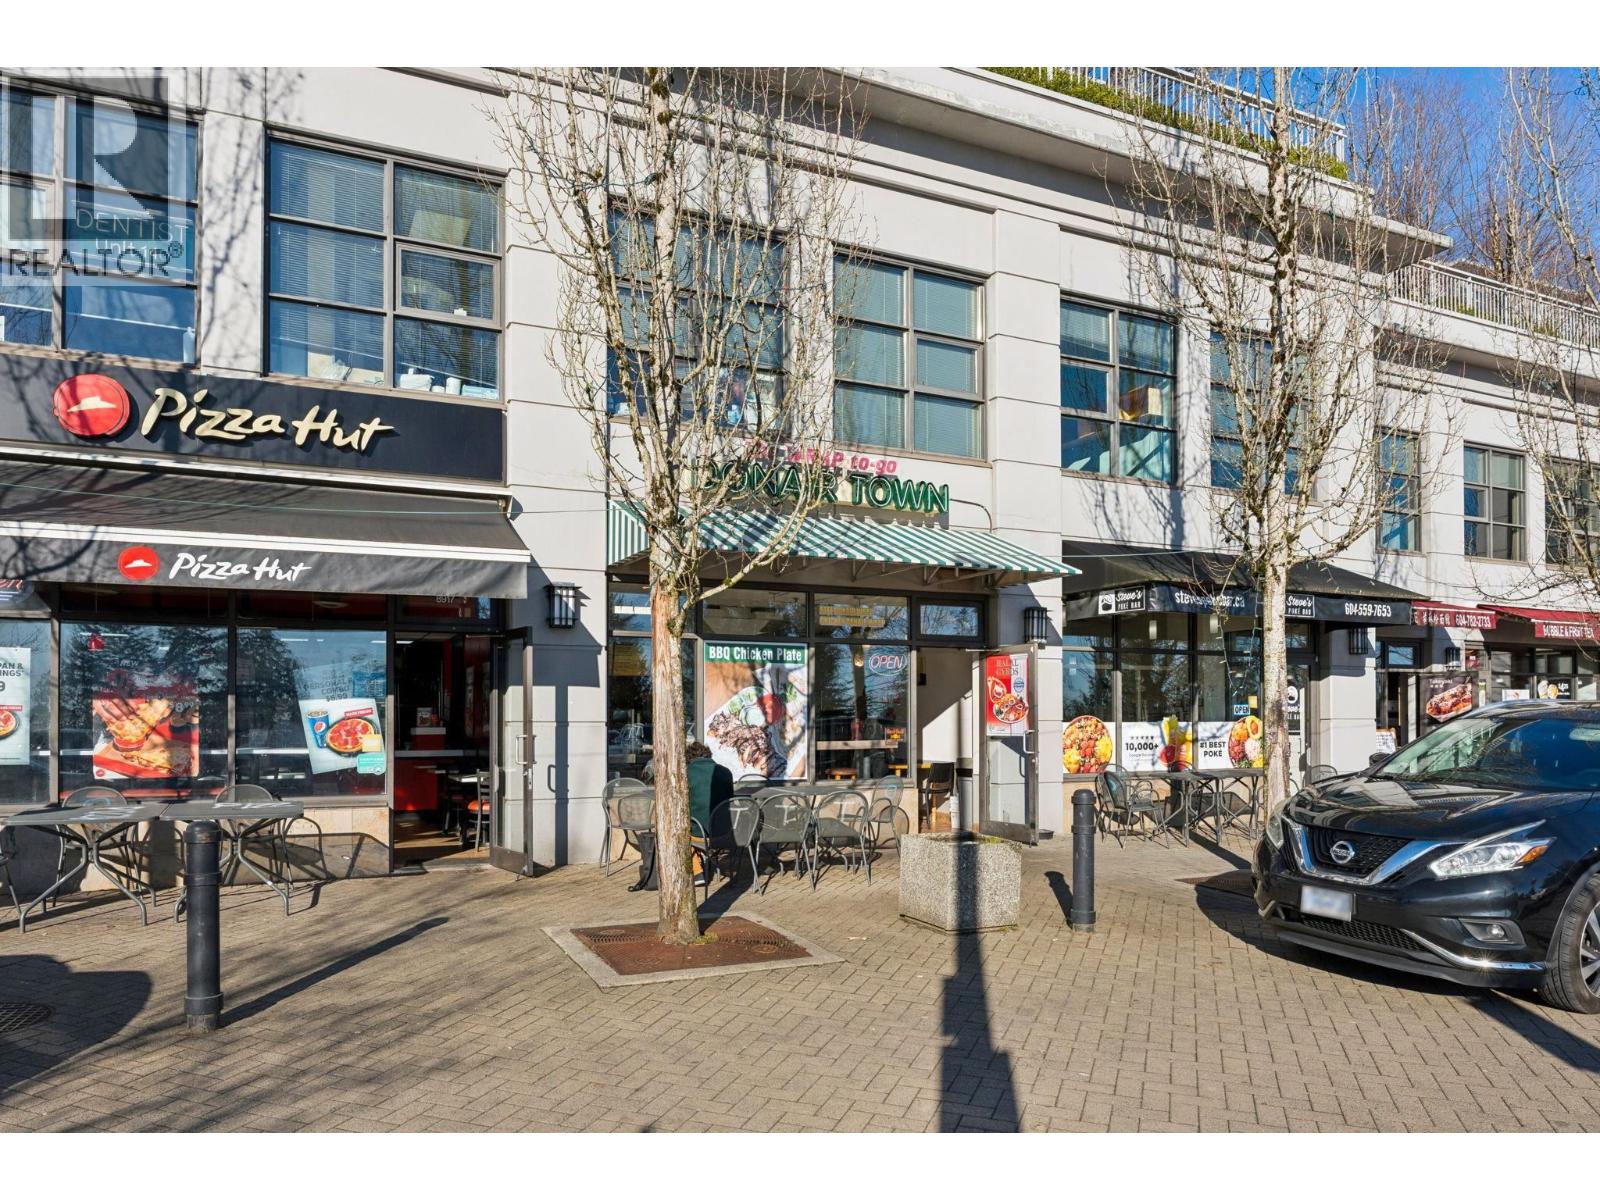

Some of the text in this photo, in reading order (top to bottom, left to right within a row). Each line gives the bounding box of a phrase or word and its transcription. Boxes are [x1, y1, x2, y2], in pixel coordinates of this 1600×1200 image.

[76, 209, 189, 243] DENTIST
[141, 387, 395, 451] Pizza Hut
[850, 451, 898, 475] to-go
[850, 473, 950, 513] TOWN
[169, 552, 312, 582] Pizza Hut
[1116, 590, 1143, 602] Steve's
[1286, 596, 1313, 607] Steve's
[1344, 603, 1392, 618] 604-559-7653
[708, 645, 802, 662] BBQ Chicken Plate
[870, 654, 904, 670] OPEN
[1234, 705, 1249, 714] OPEN
[1125, 742, 1159, 752] 10,000+
[1209, 741, 1226, 749] BEST
